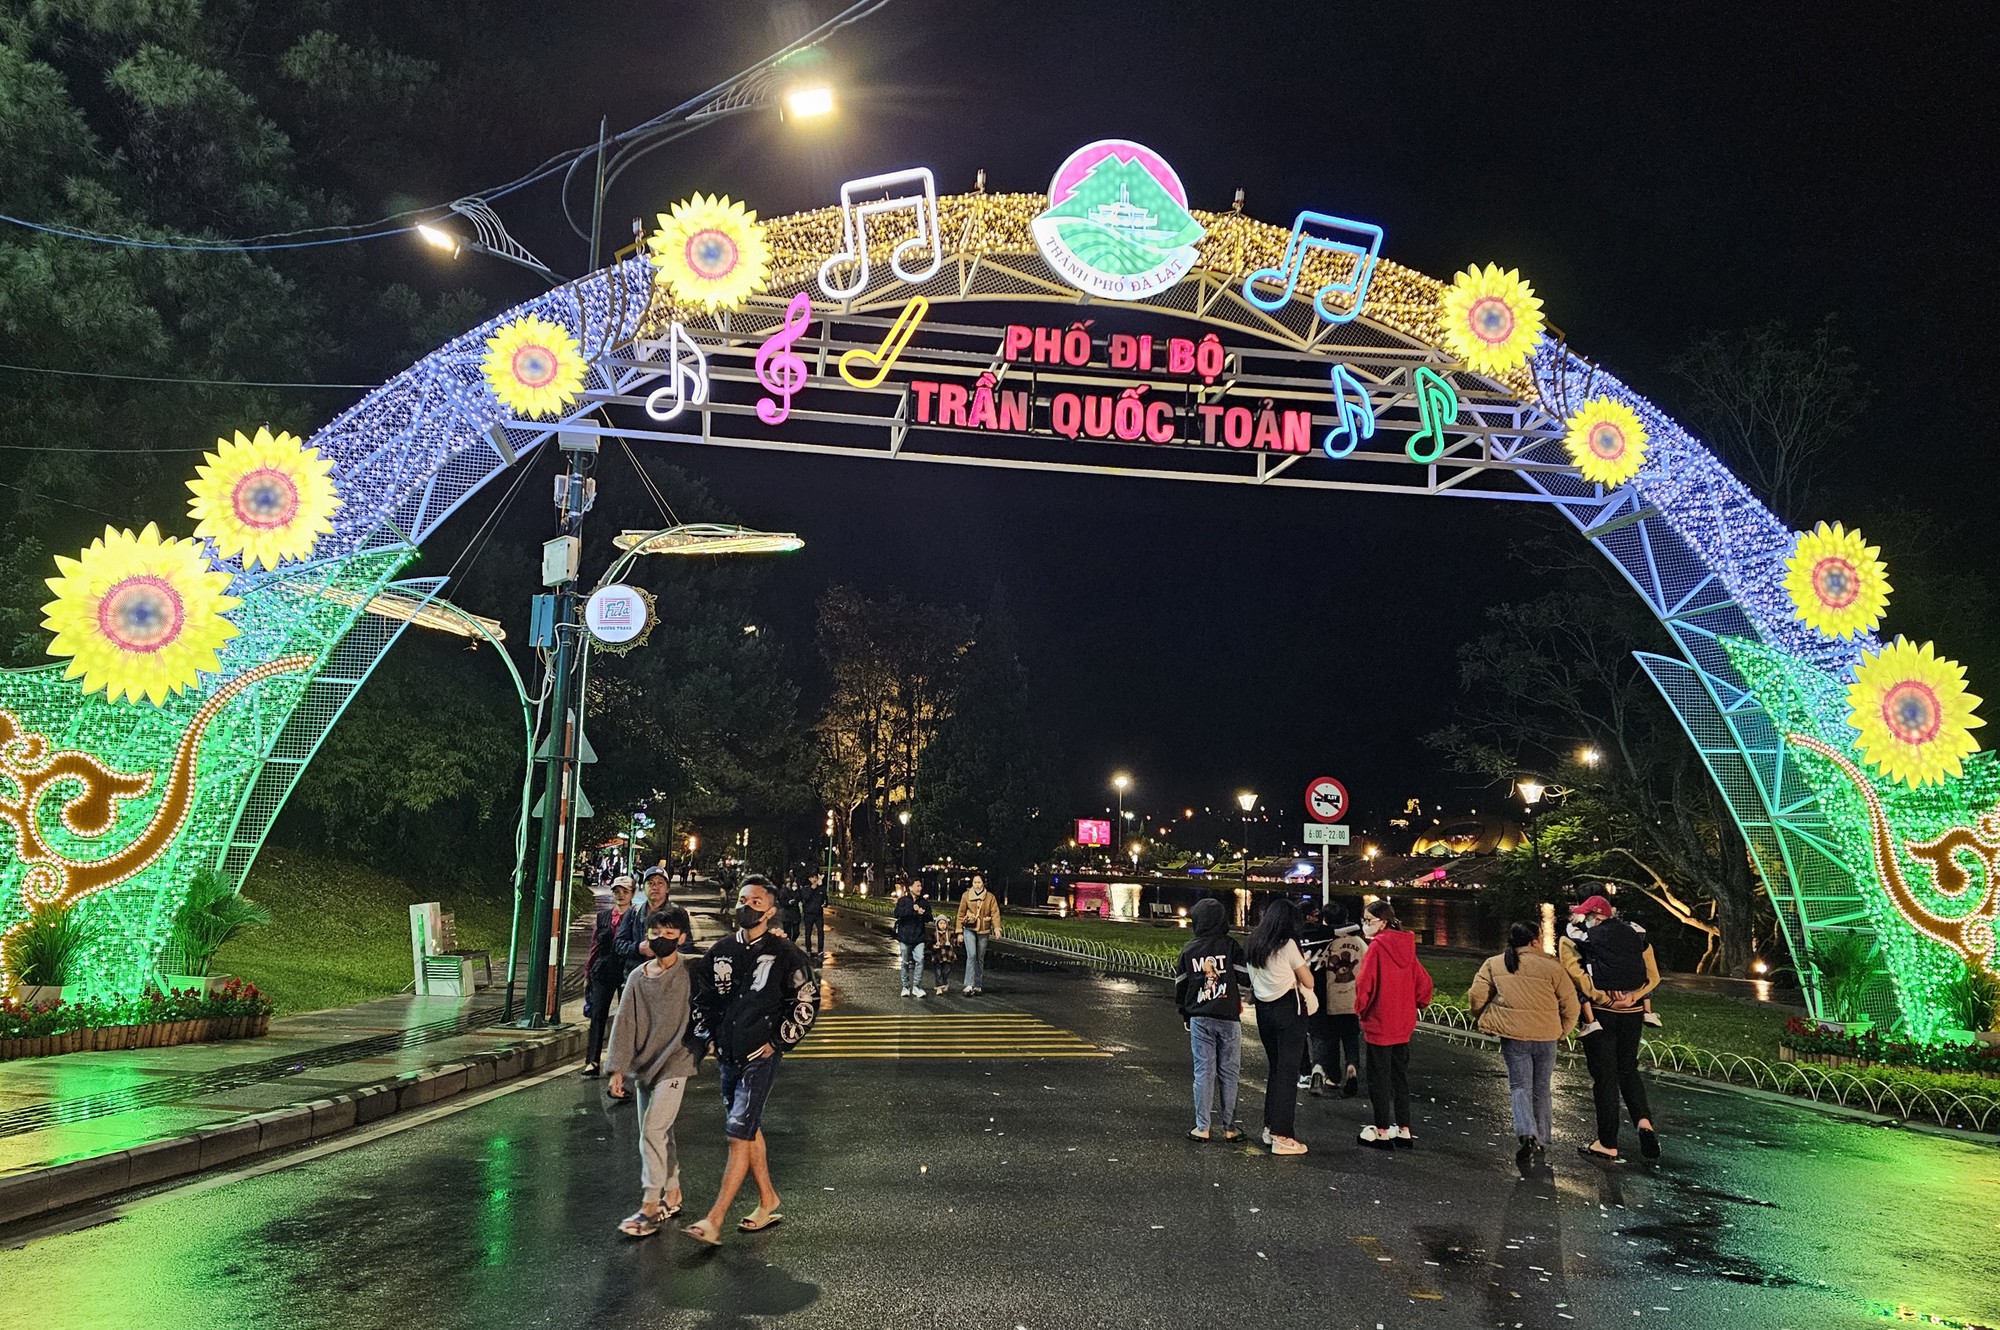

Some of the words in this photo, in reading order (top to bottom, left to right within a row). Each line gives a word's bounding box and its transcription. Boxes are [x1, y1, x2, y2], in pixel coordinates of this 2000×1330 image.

[1046, 236, 1088, 282] THÀNH
[1093, 276, 1125, 293] PHỐ
[1131, 275, 1154, 293] ĐÀ
[1156, 258, 1184, 284] LẠT
[1005, 319, 1096, 367] PHỐ
[1109, 333, 1152, 372] ĐI
[1167, 332, 1226, 386] BỘ
[910, 371, 1029, 432] TRẦN
[1051, 384, 1176, 443] QUỐC
[1199, 398, 1312, 453] TOẢN
[1309, 829, 1322, 838] 6:00
[1329, 831, 1345, 839] 22:00
